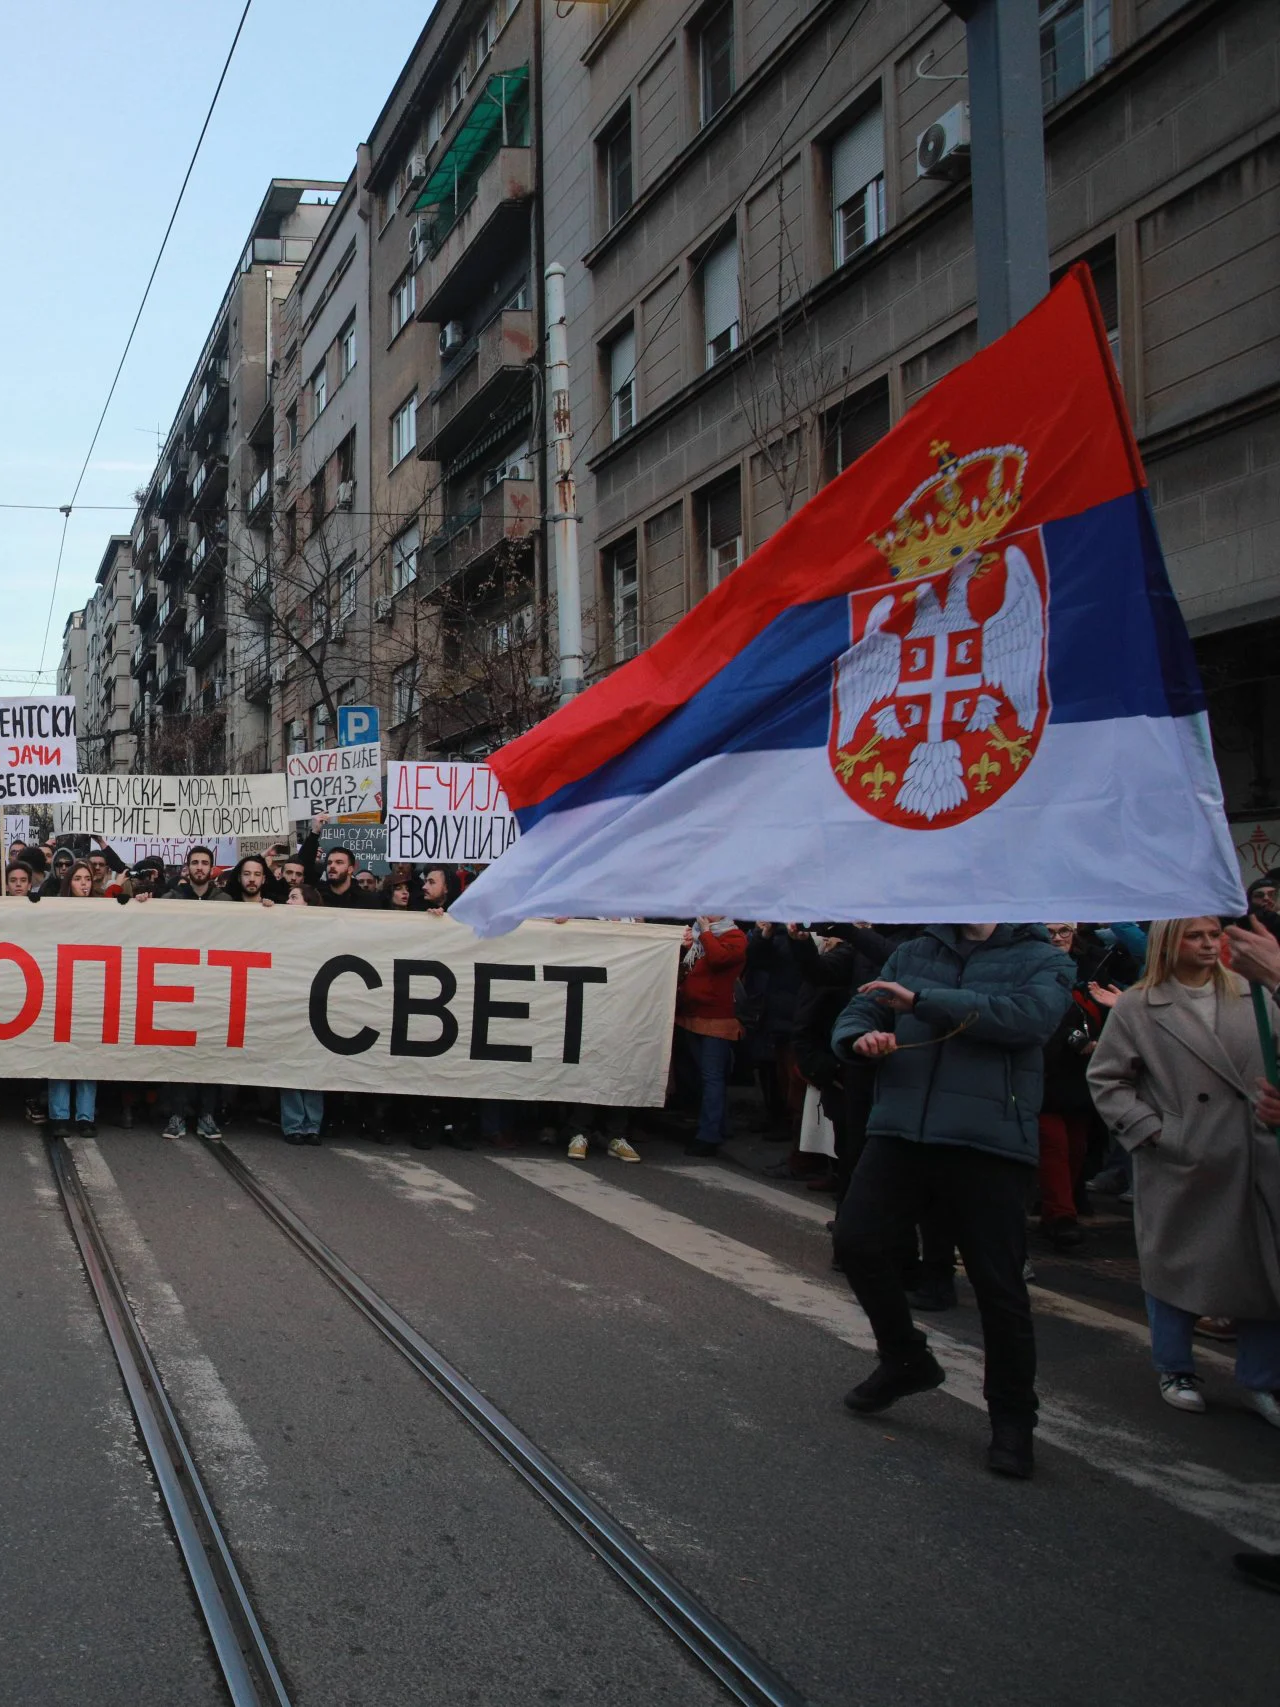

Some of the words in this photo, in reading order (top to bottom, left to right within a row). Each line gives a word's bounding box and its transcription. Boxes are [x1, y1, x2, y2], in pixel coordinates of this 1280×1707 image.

[348, 711, 370, 742] P
[8, 744, 61, 768] ЈАЧИ
[341, 747, 378, 770] БИЋЕ
[178, 777, 253, 807] МОРАЛНА
[293, 774, 357, 799] ПОРАЗ
[310, 793, 369, 816] ВРАГУ
[59, 804, 163, 836] ИНТЕГРИТЕТ
[179, 804, 288, 837] ОДГОВОРНОСТ
[321, 828, 346, 840] ДЕЦА
[348, 828, 362, 840] СУ
[365, 828, 388, 840] УКРА
[387, 813, 517, 860] РЕВОЛУЦИЈА
[308, 953, 608, 1065] СВЕТ
